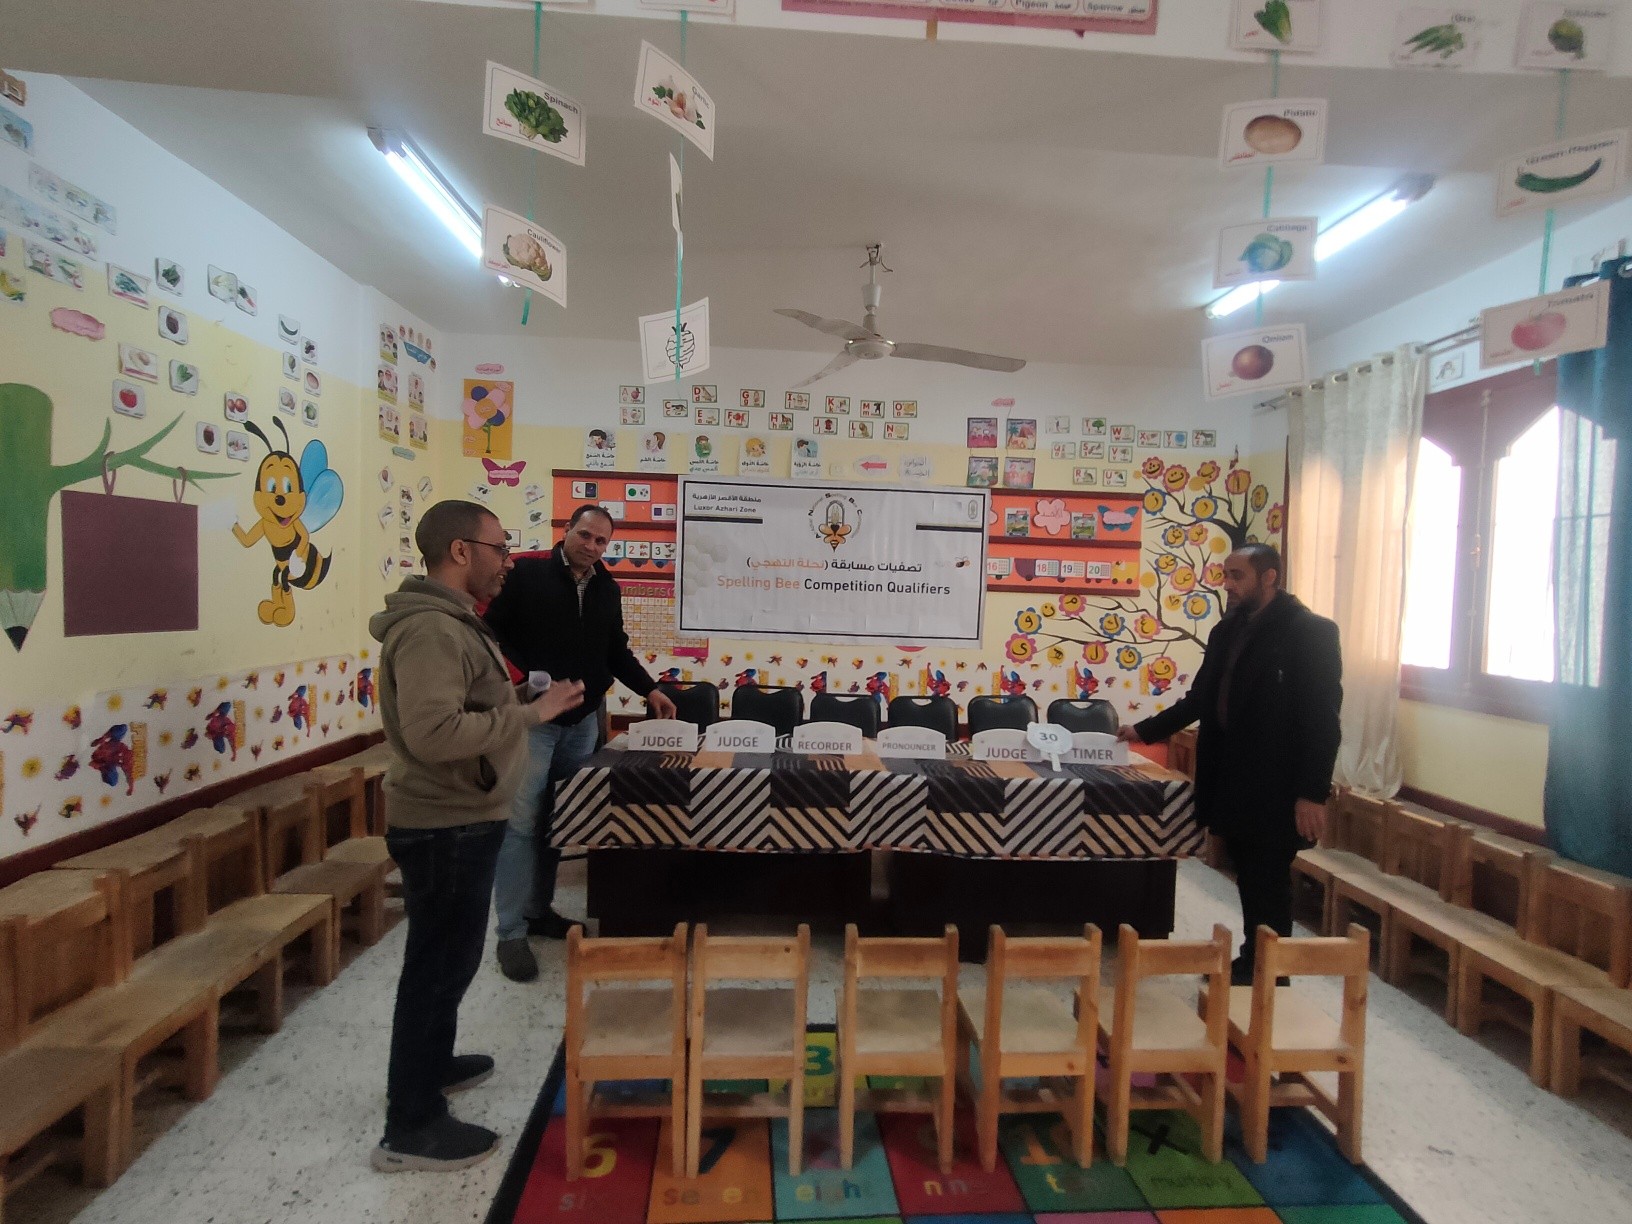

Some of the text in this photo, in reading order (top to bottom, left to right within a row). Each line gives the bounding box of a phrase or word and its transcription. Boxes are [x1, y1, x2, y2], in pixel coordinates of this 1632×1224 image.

[544, 92, 578, 114] Spinach
[1146, 462, 1160, 474] ث
[1201, 466, 1215, 479] ب
[1167, 471, 1184, 484] ت
[739, 494, 762, 503] منطقة
[1167, 529, 1182, 545] ش
[1190, 528, 1203, 542] س
[629, 546, 634, 554] 2
[655, 547, 661, 555] 3
[831, 559, 874, 572] مسابقة
[878, 562, 922, 573] تصفيات
[987, 562, 998, 571] 16
[1037, 564, 1047, 573] 18
[1159, 556, 1176, 569] ض
[1063, 565, 1073, 573] 19
[1089, 566, 1100, 574] 20
[1210, 569, 1222, 581] ط
[717, 575, 950, 595] Spelling Bee Competition Qualifiers
[1175, 573, 1192, 585] ص
[1169, 595, 1180, 606] ظ
[1191, 598, 1203, 615] ع
[1042, 605, 1055, 617] ن
[1025, 615, 1033, 628] و
[1104, 615, 1119, 630] ك
[1090, 645, 1098, 660] ل
[1154, 661, 1171, 675] ف
[641, 736, 683, 747] JUDGE
[717, 736, 759, 747] JUDGE
[1039, 732, 1058, 742] 30
[798, 741, 852, 751] RECORDER
[986, 747, 1027, 759] JUDGE
[1072, 748, 1113, 760] TIMER
[804, 1045, 834, 1076] 3
[699, 1124, 738, 1174] 7
